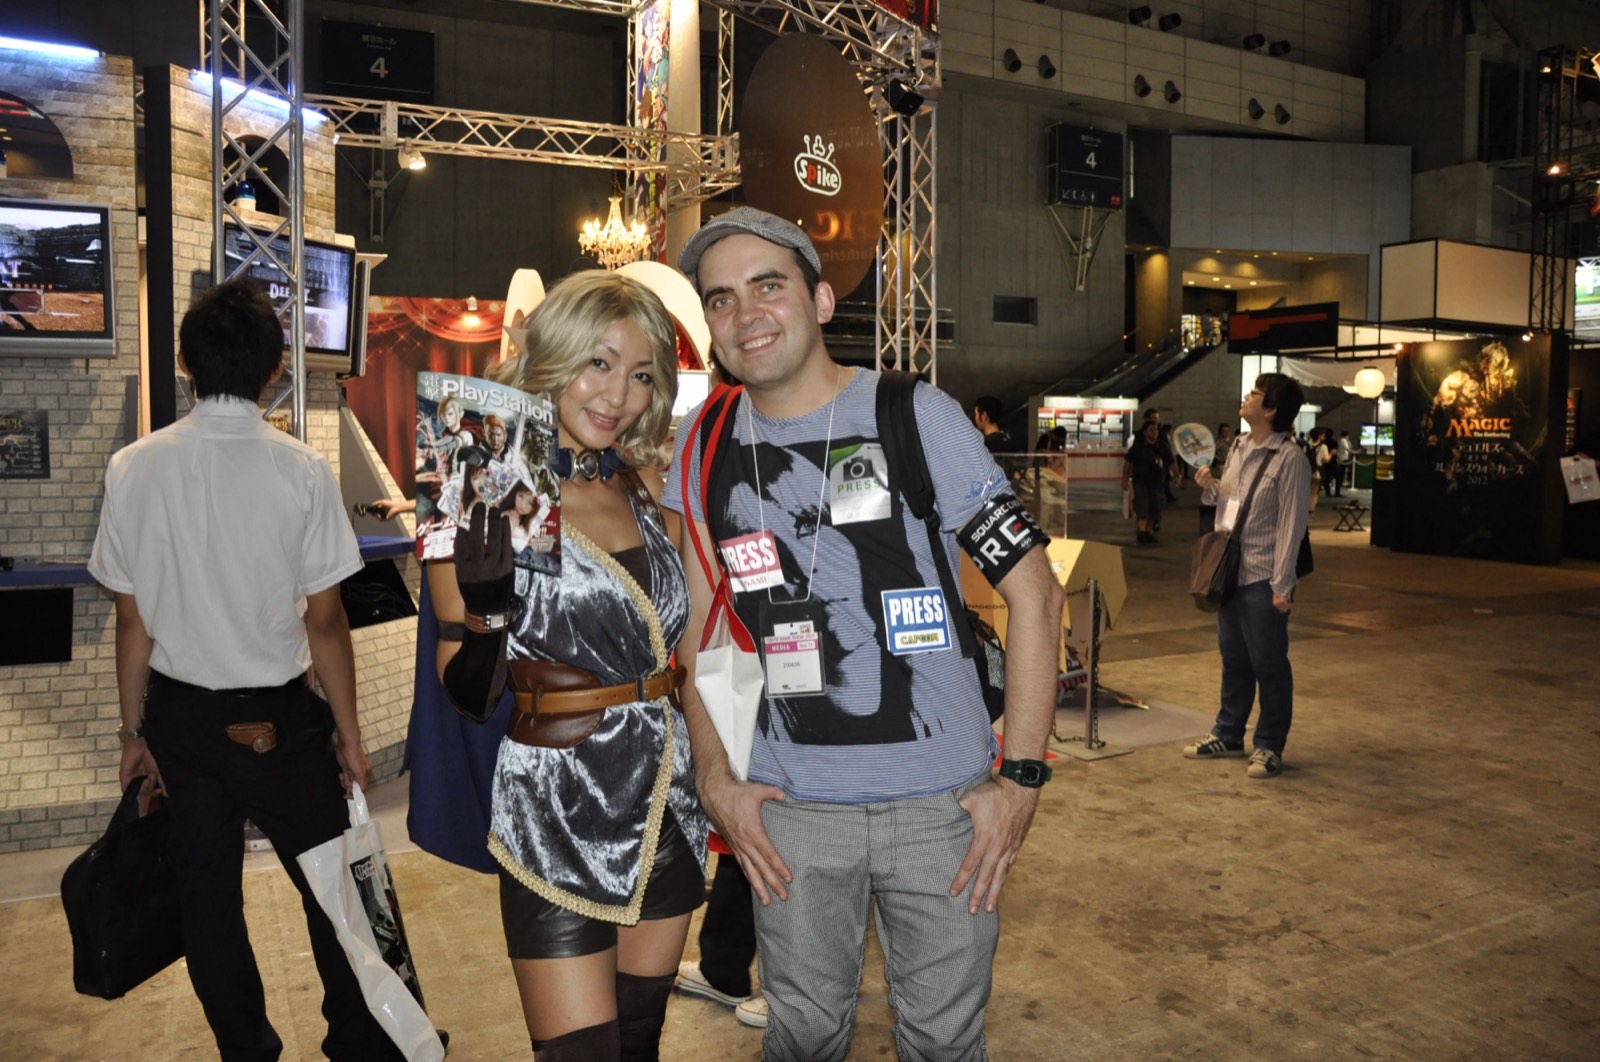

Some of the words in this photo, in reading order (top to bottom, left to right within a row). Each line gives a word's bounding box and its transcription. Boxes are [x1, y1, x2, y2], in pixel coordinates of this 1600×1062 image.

[369, 57, 389, 78] 4
[1085, 152, 1097, 168] 4
[799, 159, 838, 188] Spike
[442, 378, 553, 425] PlayStation
[1445, 418, 1512, 438] MAGIC
[1484, 431, 1511, 439] Gathering
[837, 479, 880, 494] PRESS
[743, 575, 768, 587] NAMI
[889, 594, 944, 627] PRESS
[900, 632, 939, 645] CAPCOM
[771, 644, 790, 652] MEDIA
